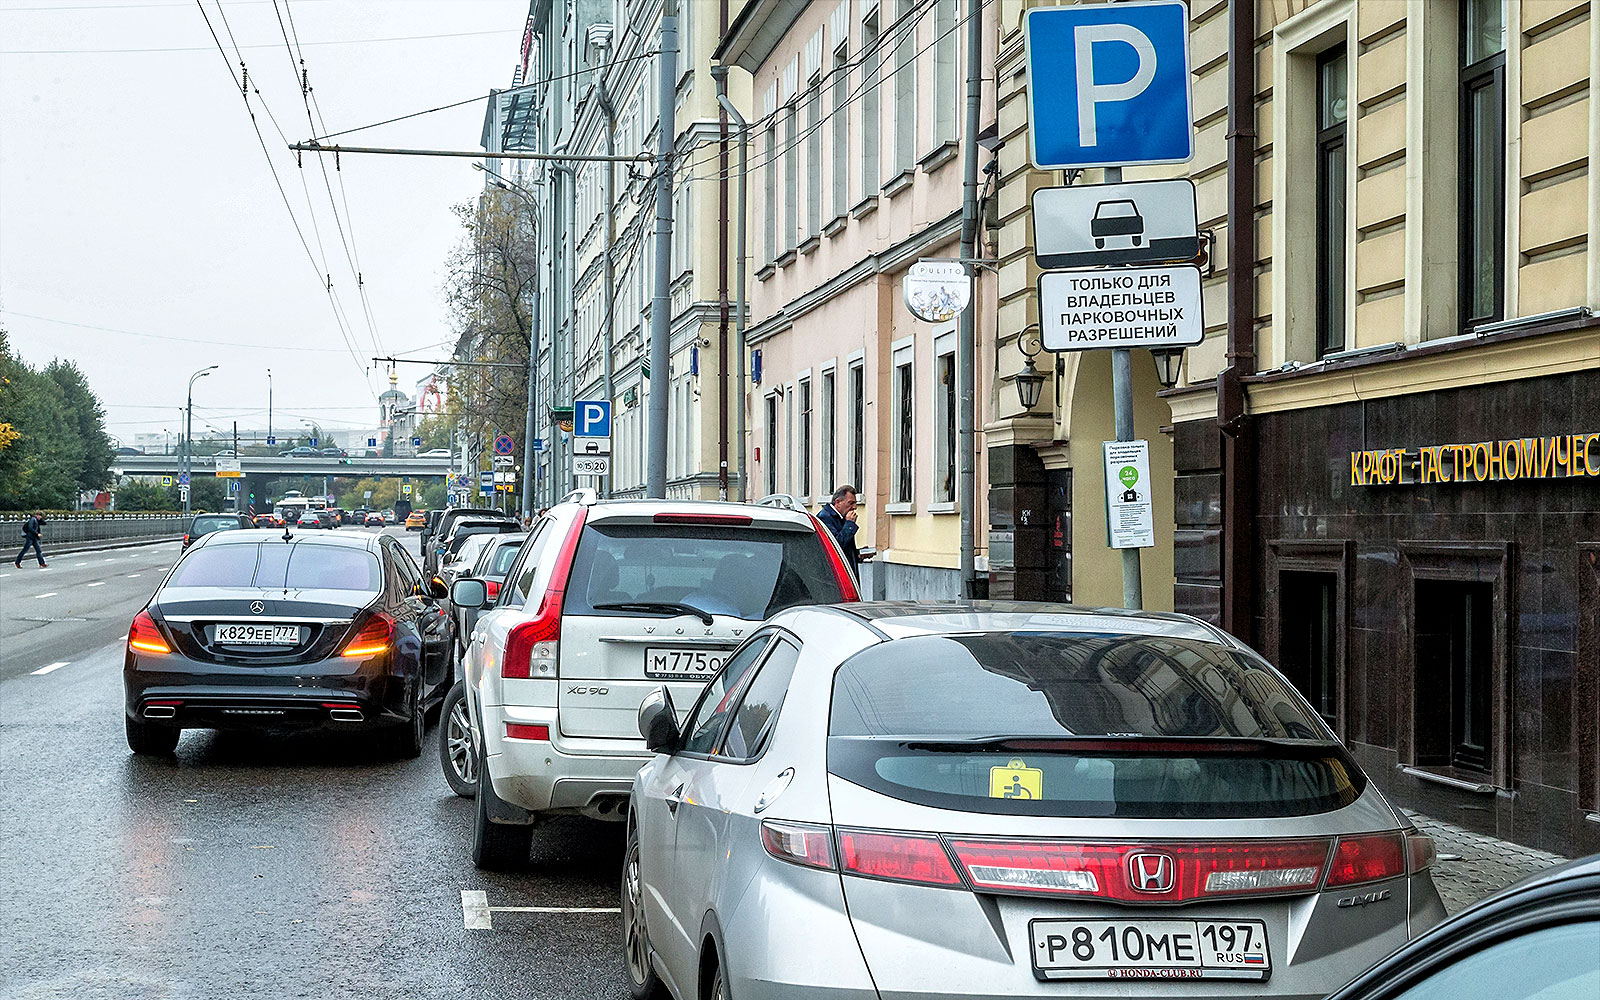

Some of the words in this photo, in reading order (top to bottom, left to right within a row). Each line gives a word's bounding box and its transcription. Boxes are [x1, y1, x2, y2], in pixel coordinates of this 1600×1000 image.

[1074, 23, 1158, 148] P
[920, 267, 961, 275] PULITO
[1070, 277, 1133, 291] ТОЛЬКО
[1138, 274, 1171, 289] ДЛЯ
[1067, 291, 1176, 309] ВЛАДЕЛЬЦЕВ
[1060, 308, 1184, 325] ПАРКОВОЧНЫХ
[1068, 323, 1177, 342] РАЗРЕШЕНИЙ
[583, 404, 605, 433] P
[585, 462, 592, 470] 15
[594, 462, 605, 471] 20
[1350, 448, 1406, 486] КРАФТ
[1420, 433, 1600, 484] ГАСТРОНОМИЧЕС
[219, 626, 272, 640] К829ЕЕ
[275, 626, 295, 637] 777
[1337, 888, 1392, 908] CIVIC
[1047, 926, 1195, 962] Р810МЕ
[1202, 924, 1253, 952] 197
[1217, 952, 1243, 963] RUS
[1120, 968, 1203, 978] HONDA-CLUB.RU
